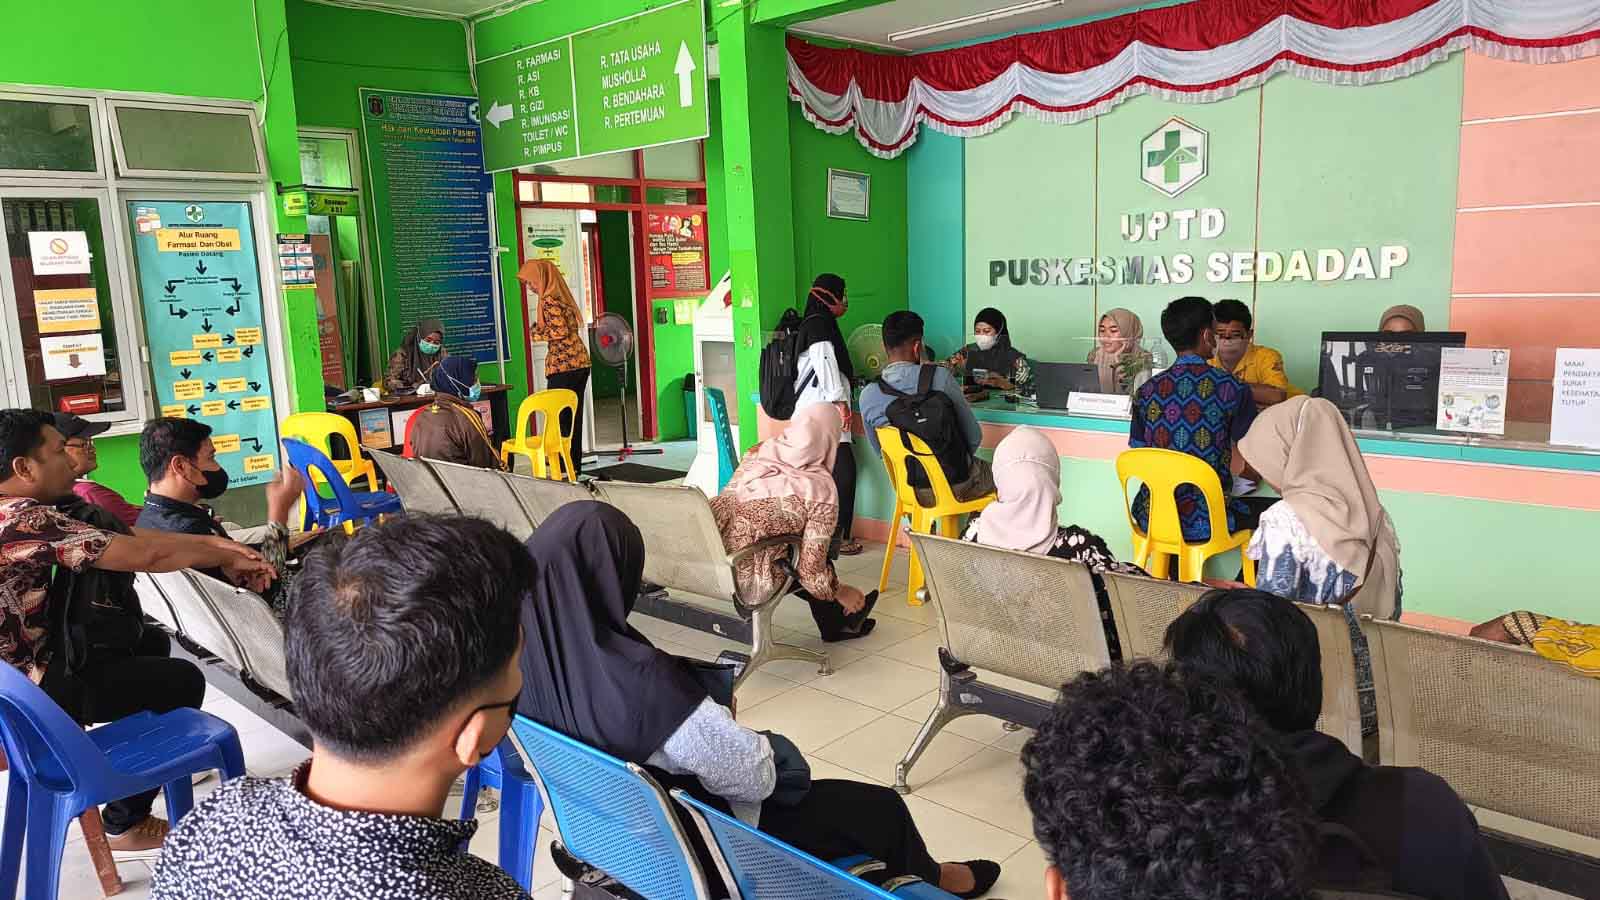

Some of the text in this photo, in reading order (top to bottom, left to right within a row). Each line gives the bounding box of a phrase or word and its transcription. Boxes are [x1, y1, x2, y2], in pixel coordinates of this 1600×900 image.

[516, 49, 561, 70] R. FARMASI
[600, 40, 661, 69] R. TATA USAHA
[518, 71, 540, 85] R. ASI
[602, 65, 647, 89] MUSHOLLA
[519, 86, 540, 99] R. KB
[603, 82, 665, 110] R. BENDAHARA
[520, 100, 545, 114] R. GIZI
[521, 109, 570, 129] R. IMUNISASI
[604, 105, 665, 129] R. PERTEMUAN
[522, 128, 549, 143] TOILET
[554, 125, 568, 137] WC
[524, 141, 562, 158] R. PIMPUS
[1120, 208, 1226, 242] UPTD
[178, 231, 218, 240] Alur Ruang
[214, 240, 232, 248] Obat
[988, 245, 1409, 287] PUSKESMAS SEDADAP
[1376, 342, 1412, 354] acer
